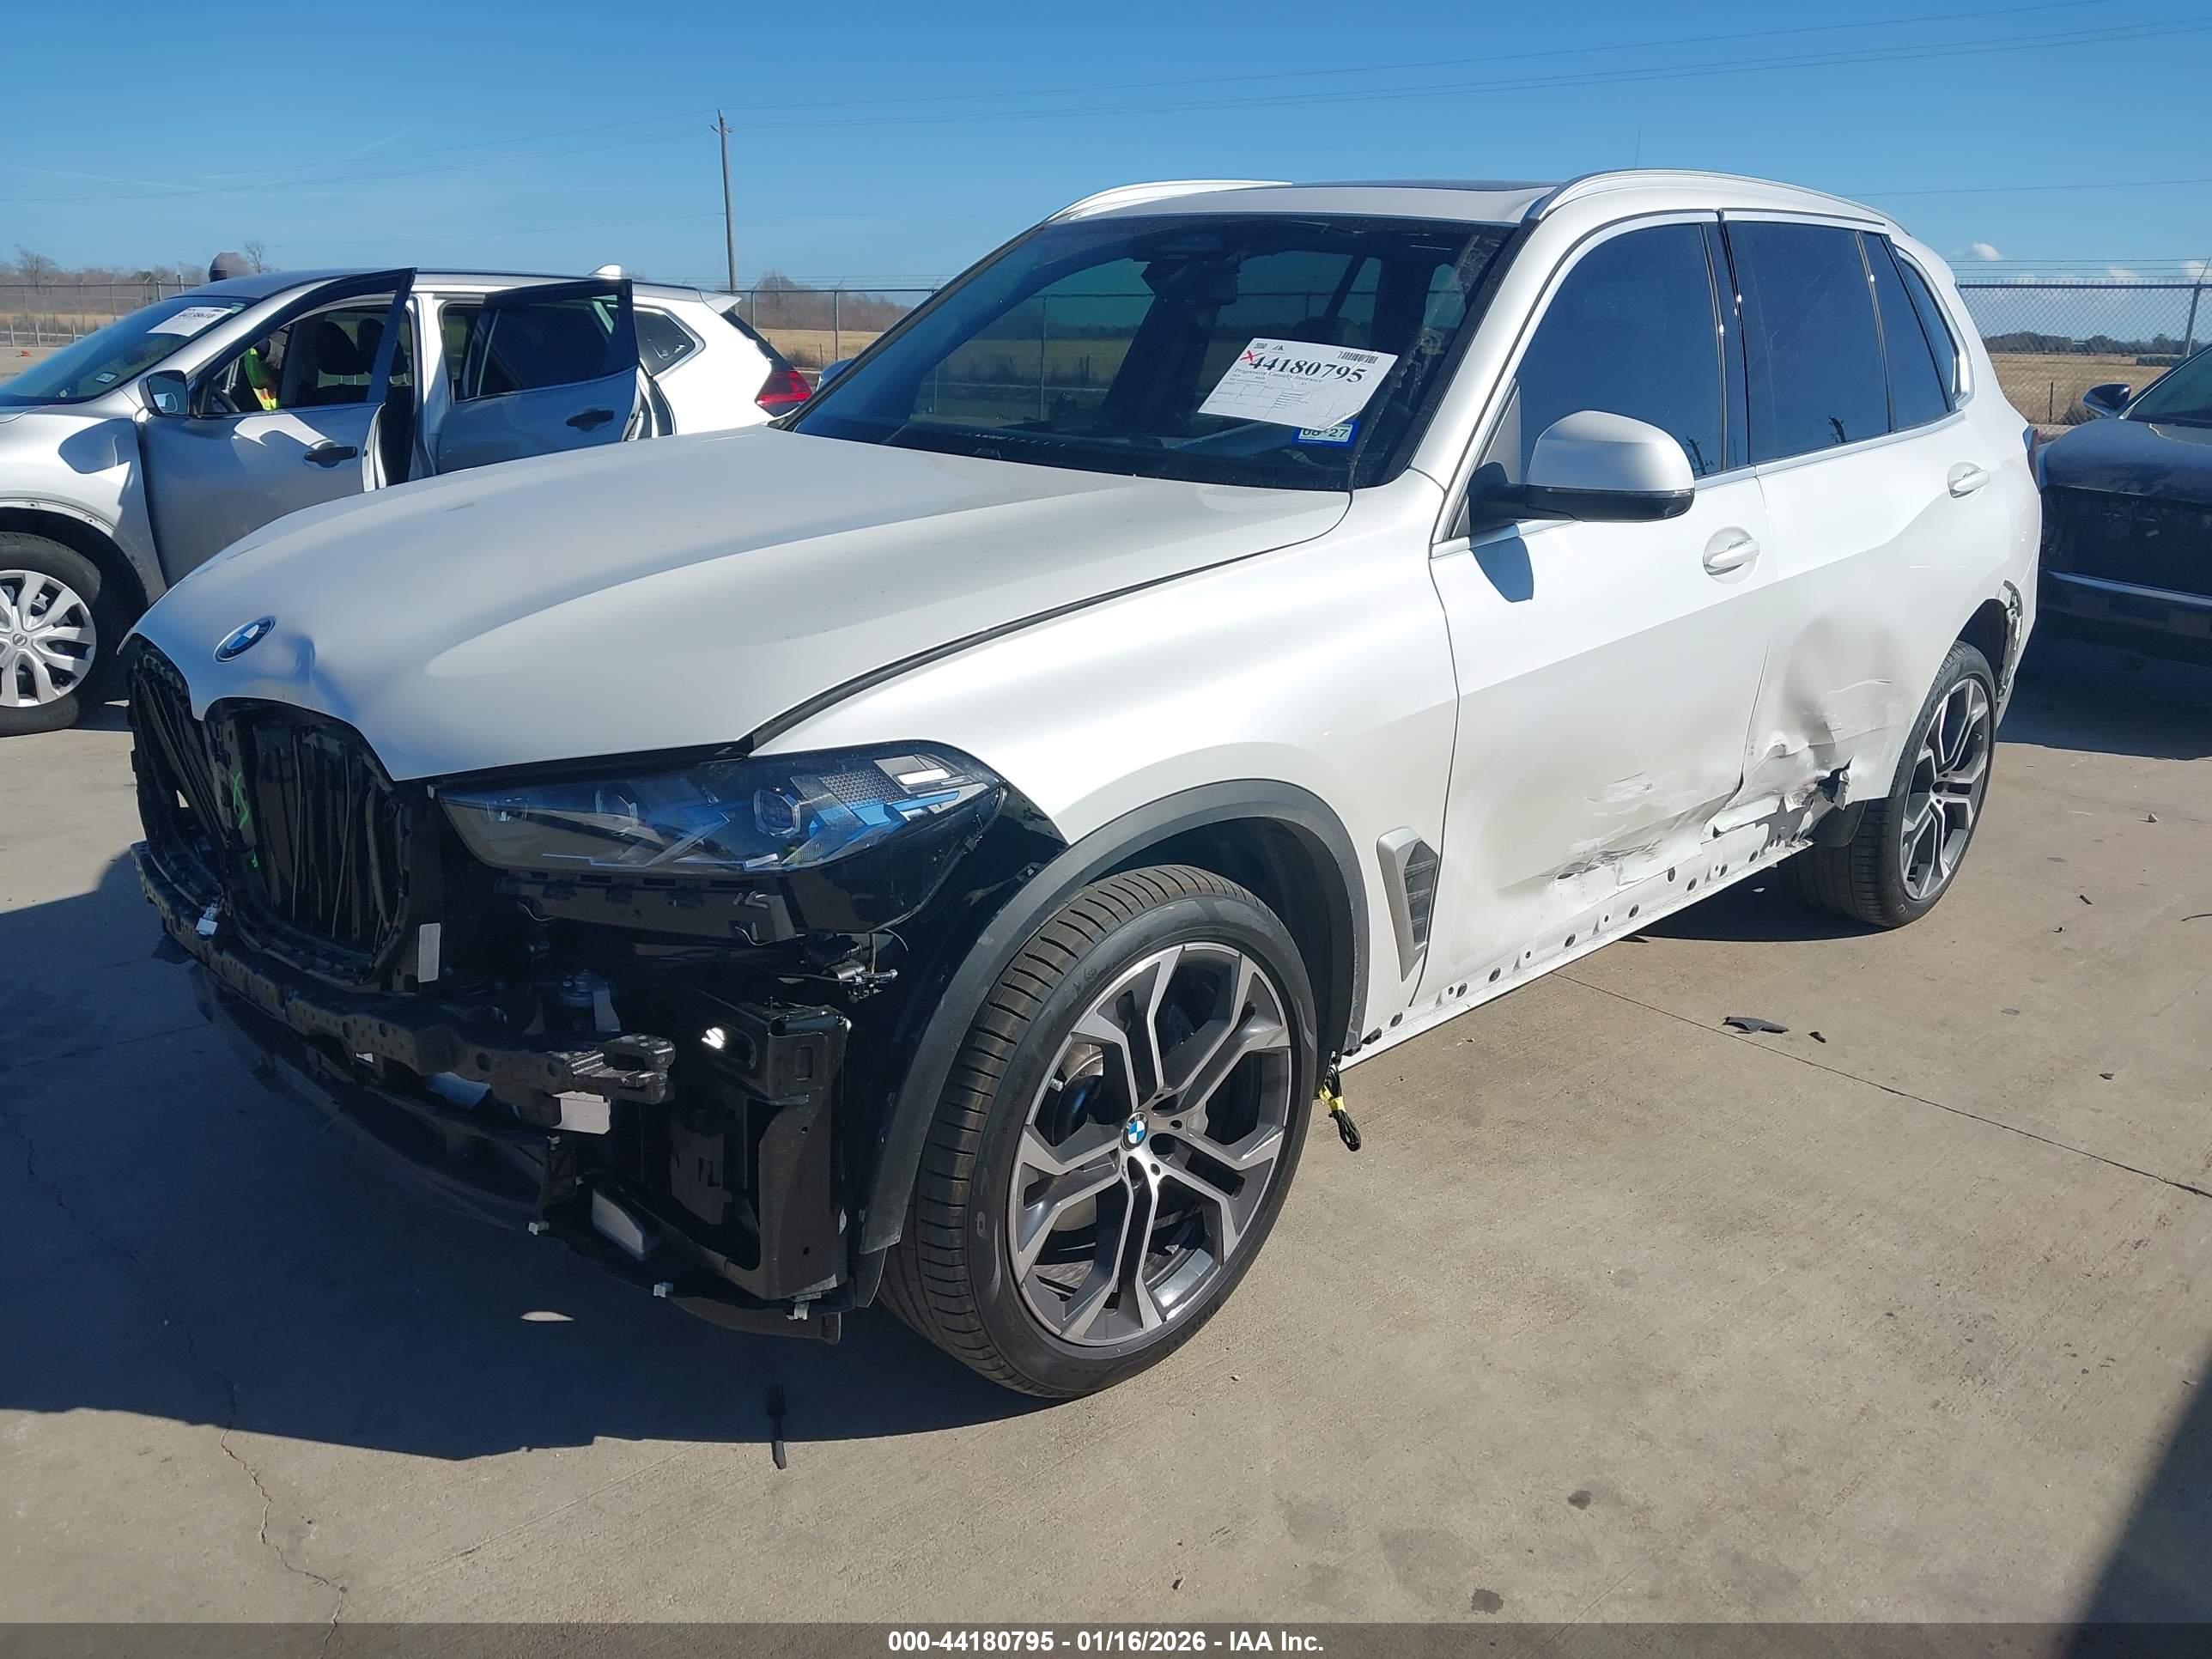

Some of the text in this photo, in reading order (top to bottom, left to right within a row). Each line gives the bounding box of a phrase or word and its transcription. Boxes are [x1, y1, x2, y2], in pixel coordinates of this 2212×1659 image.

[1249, 356, 1368, 383] 44180795
[1295, 374, 1323, 383] Insurance
[1329, 428, 1349, 437] 27
